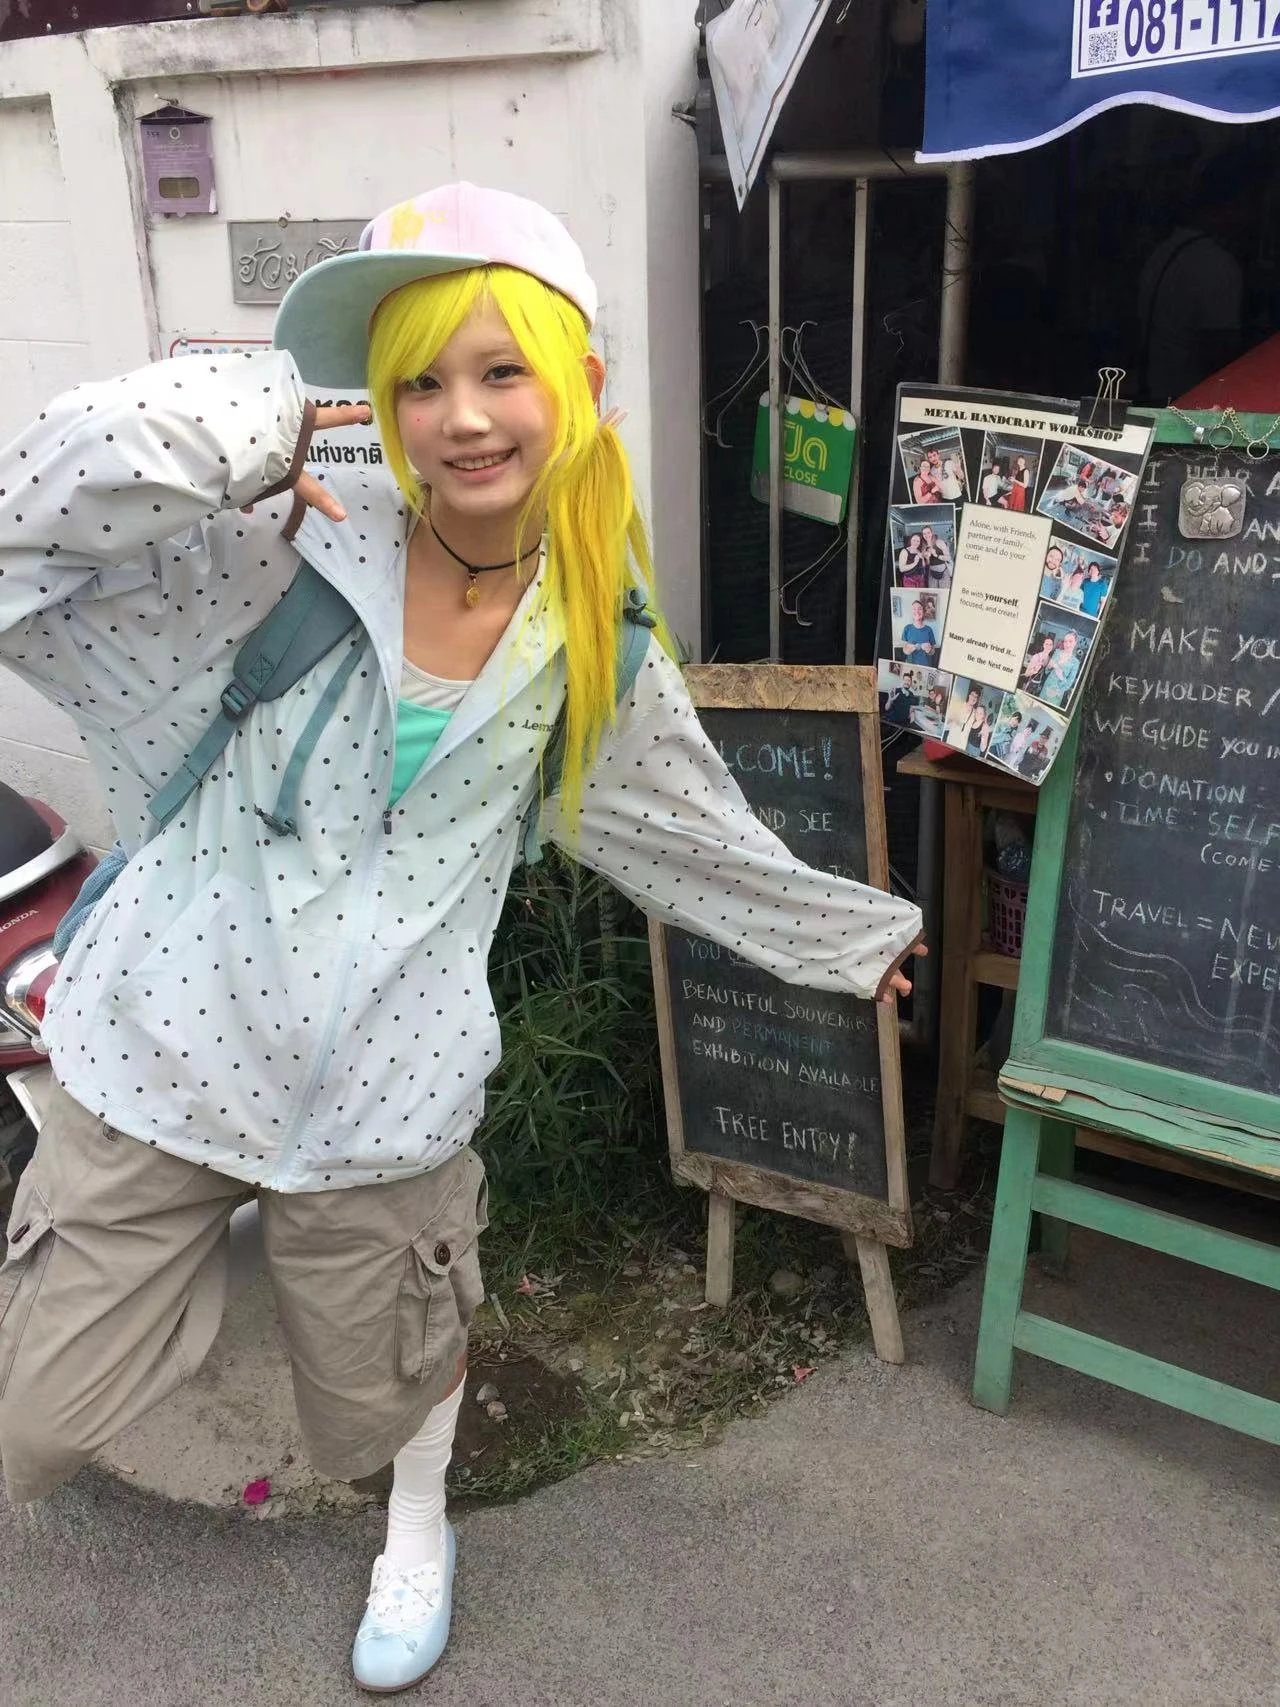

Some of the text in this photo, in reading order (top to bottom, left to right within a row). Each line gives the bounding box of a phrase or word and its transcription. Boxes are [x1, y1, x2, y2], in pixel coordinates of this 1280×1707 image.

[924, 407, 1123, 442] METAL HANDCRAFT WORKSHOP
[967, 531, 992, 541] partner
[969, 519, 991, 531] Alone,
[993, 524, 1009, 533] with
[963, 552, 980, 562] craft
[965, 542, 1026, 561] come and do your
[1168, 546, 1202, 572] DO
[1212, 552, 1267, 575] AND
[959, 598, 984, 611] focused,
[985, 605, 997, 614] and
[961, 587, 969, 595] Be
[970, 590, 984, 598] with
[949, 631, 965, 643] Many
[966, 636, 989, 649] already
[990, 644, 1005, 654] tried
[1130, 621, 1222, 656] MAKE
[967, 654, 1014, 674] Be the Next one
[1108, 671, 1252, 707] KEYHOLDER
[1095, 710, 1134, 736] WE
[1142, 718, 1210, 749] GUIDE
[1219, 736, 1259, 758] YOU
[1120, 766, 1247, 804] DONATION
[749, 804, 833, 833] ND SEE
[1115, 800, 1178, 825] TIME
[1093, 889, 1188, 928] TRAVEL
[686, 938, 720, 960] YOU
[1212, 953, 1280, 991] EXPE
[683, 978, 778, 1015] BEAUTIFUL
[692, 1013, 726, 1033] AND
[692, 1038, 790, 1075] EXHIBITION
[714, 1106, 769, 1141] FREE
